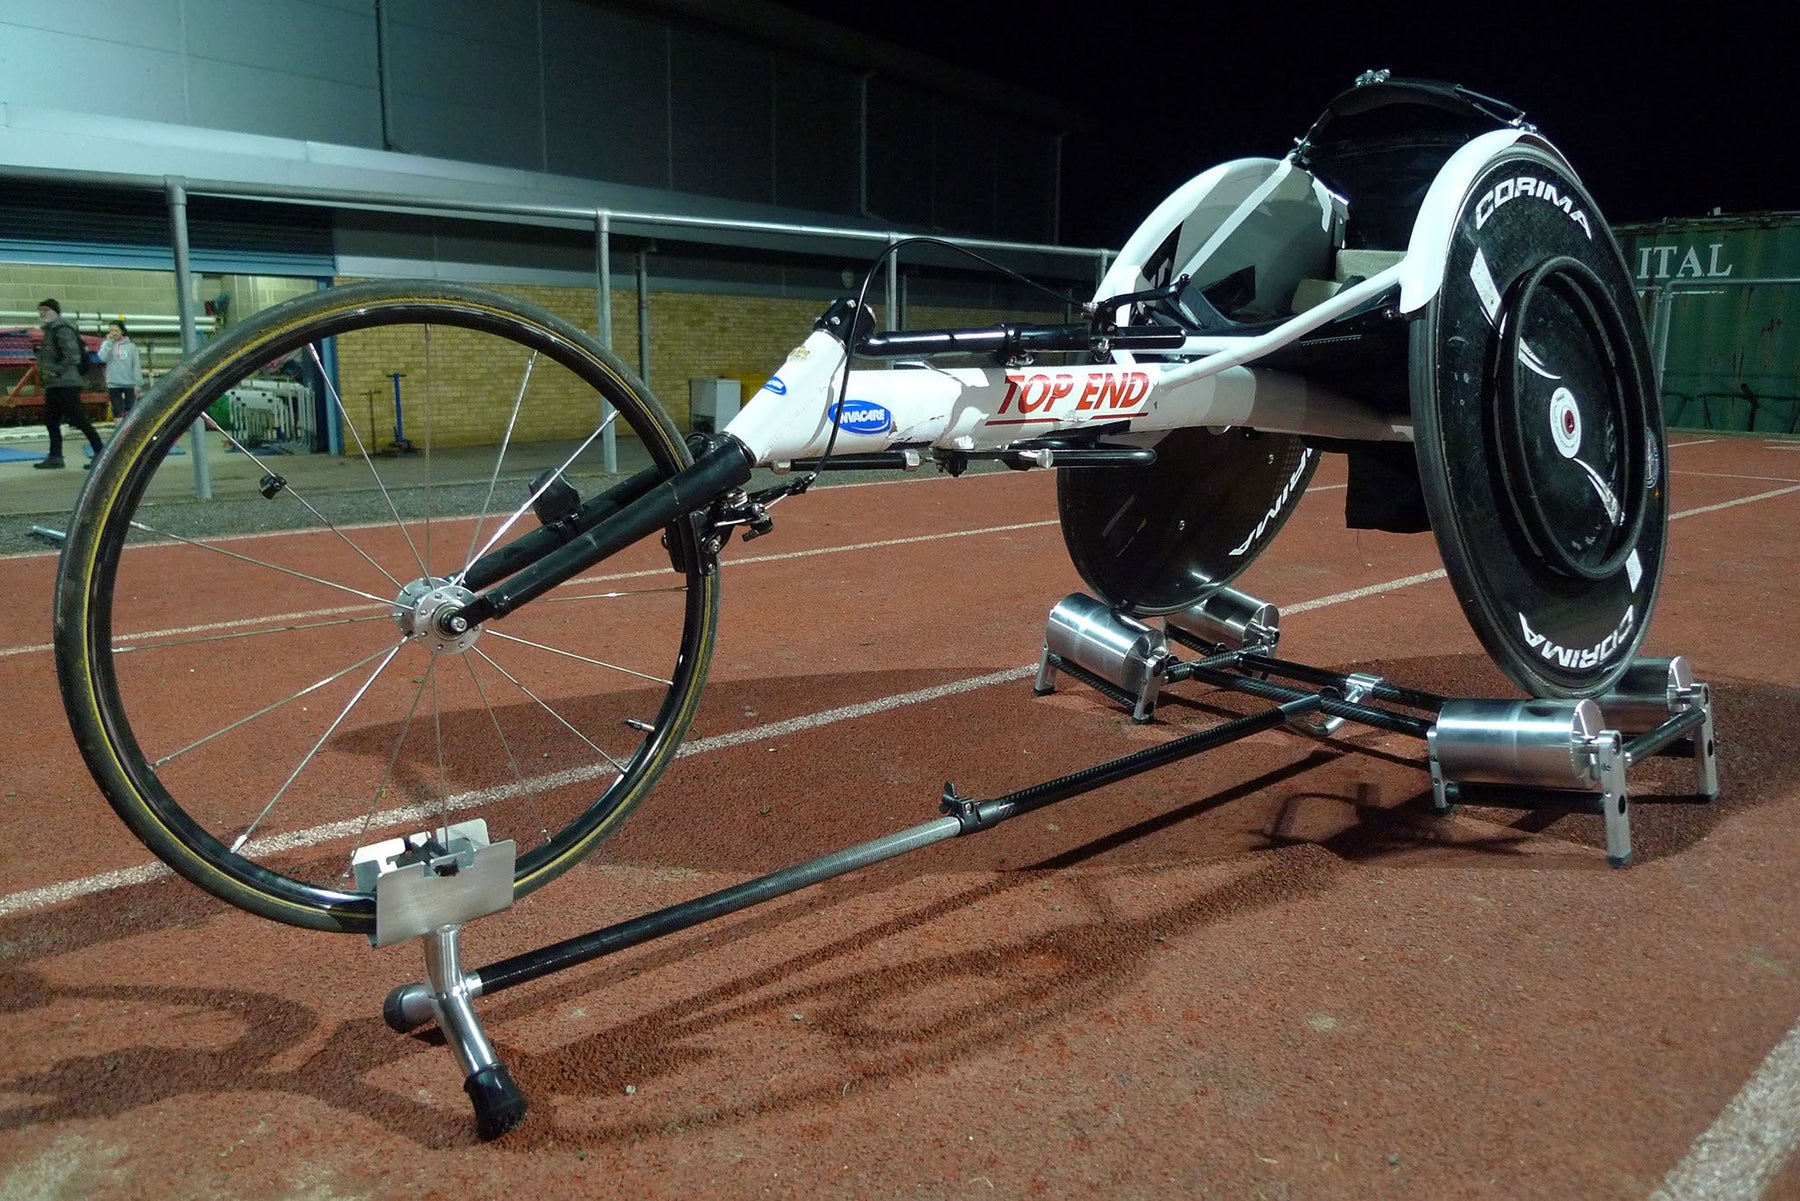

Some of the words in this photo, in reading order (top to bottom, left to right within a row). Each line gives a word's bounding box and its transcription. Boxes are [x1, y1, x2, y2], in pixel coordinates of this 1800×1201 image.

[1475, 176, 1592, 240] CORIMA
[1636, 244, 1733, 280] ITAL
[997, 373, 1075, 415] TOP
[1075, 372, 1150, 411] END
[837, 408, 885, 424] NVACARE
[1518, 604, 1634, 669] CORIMA
